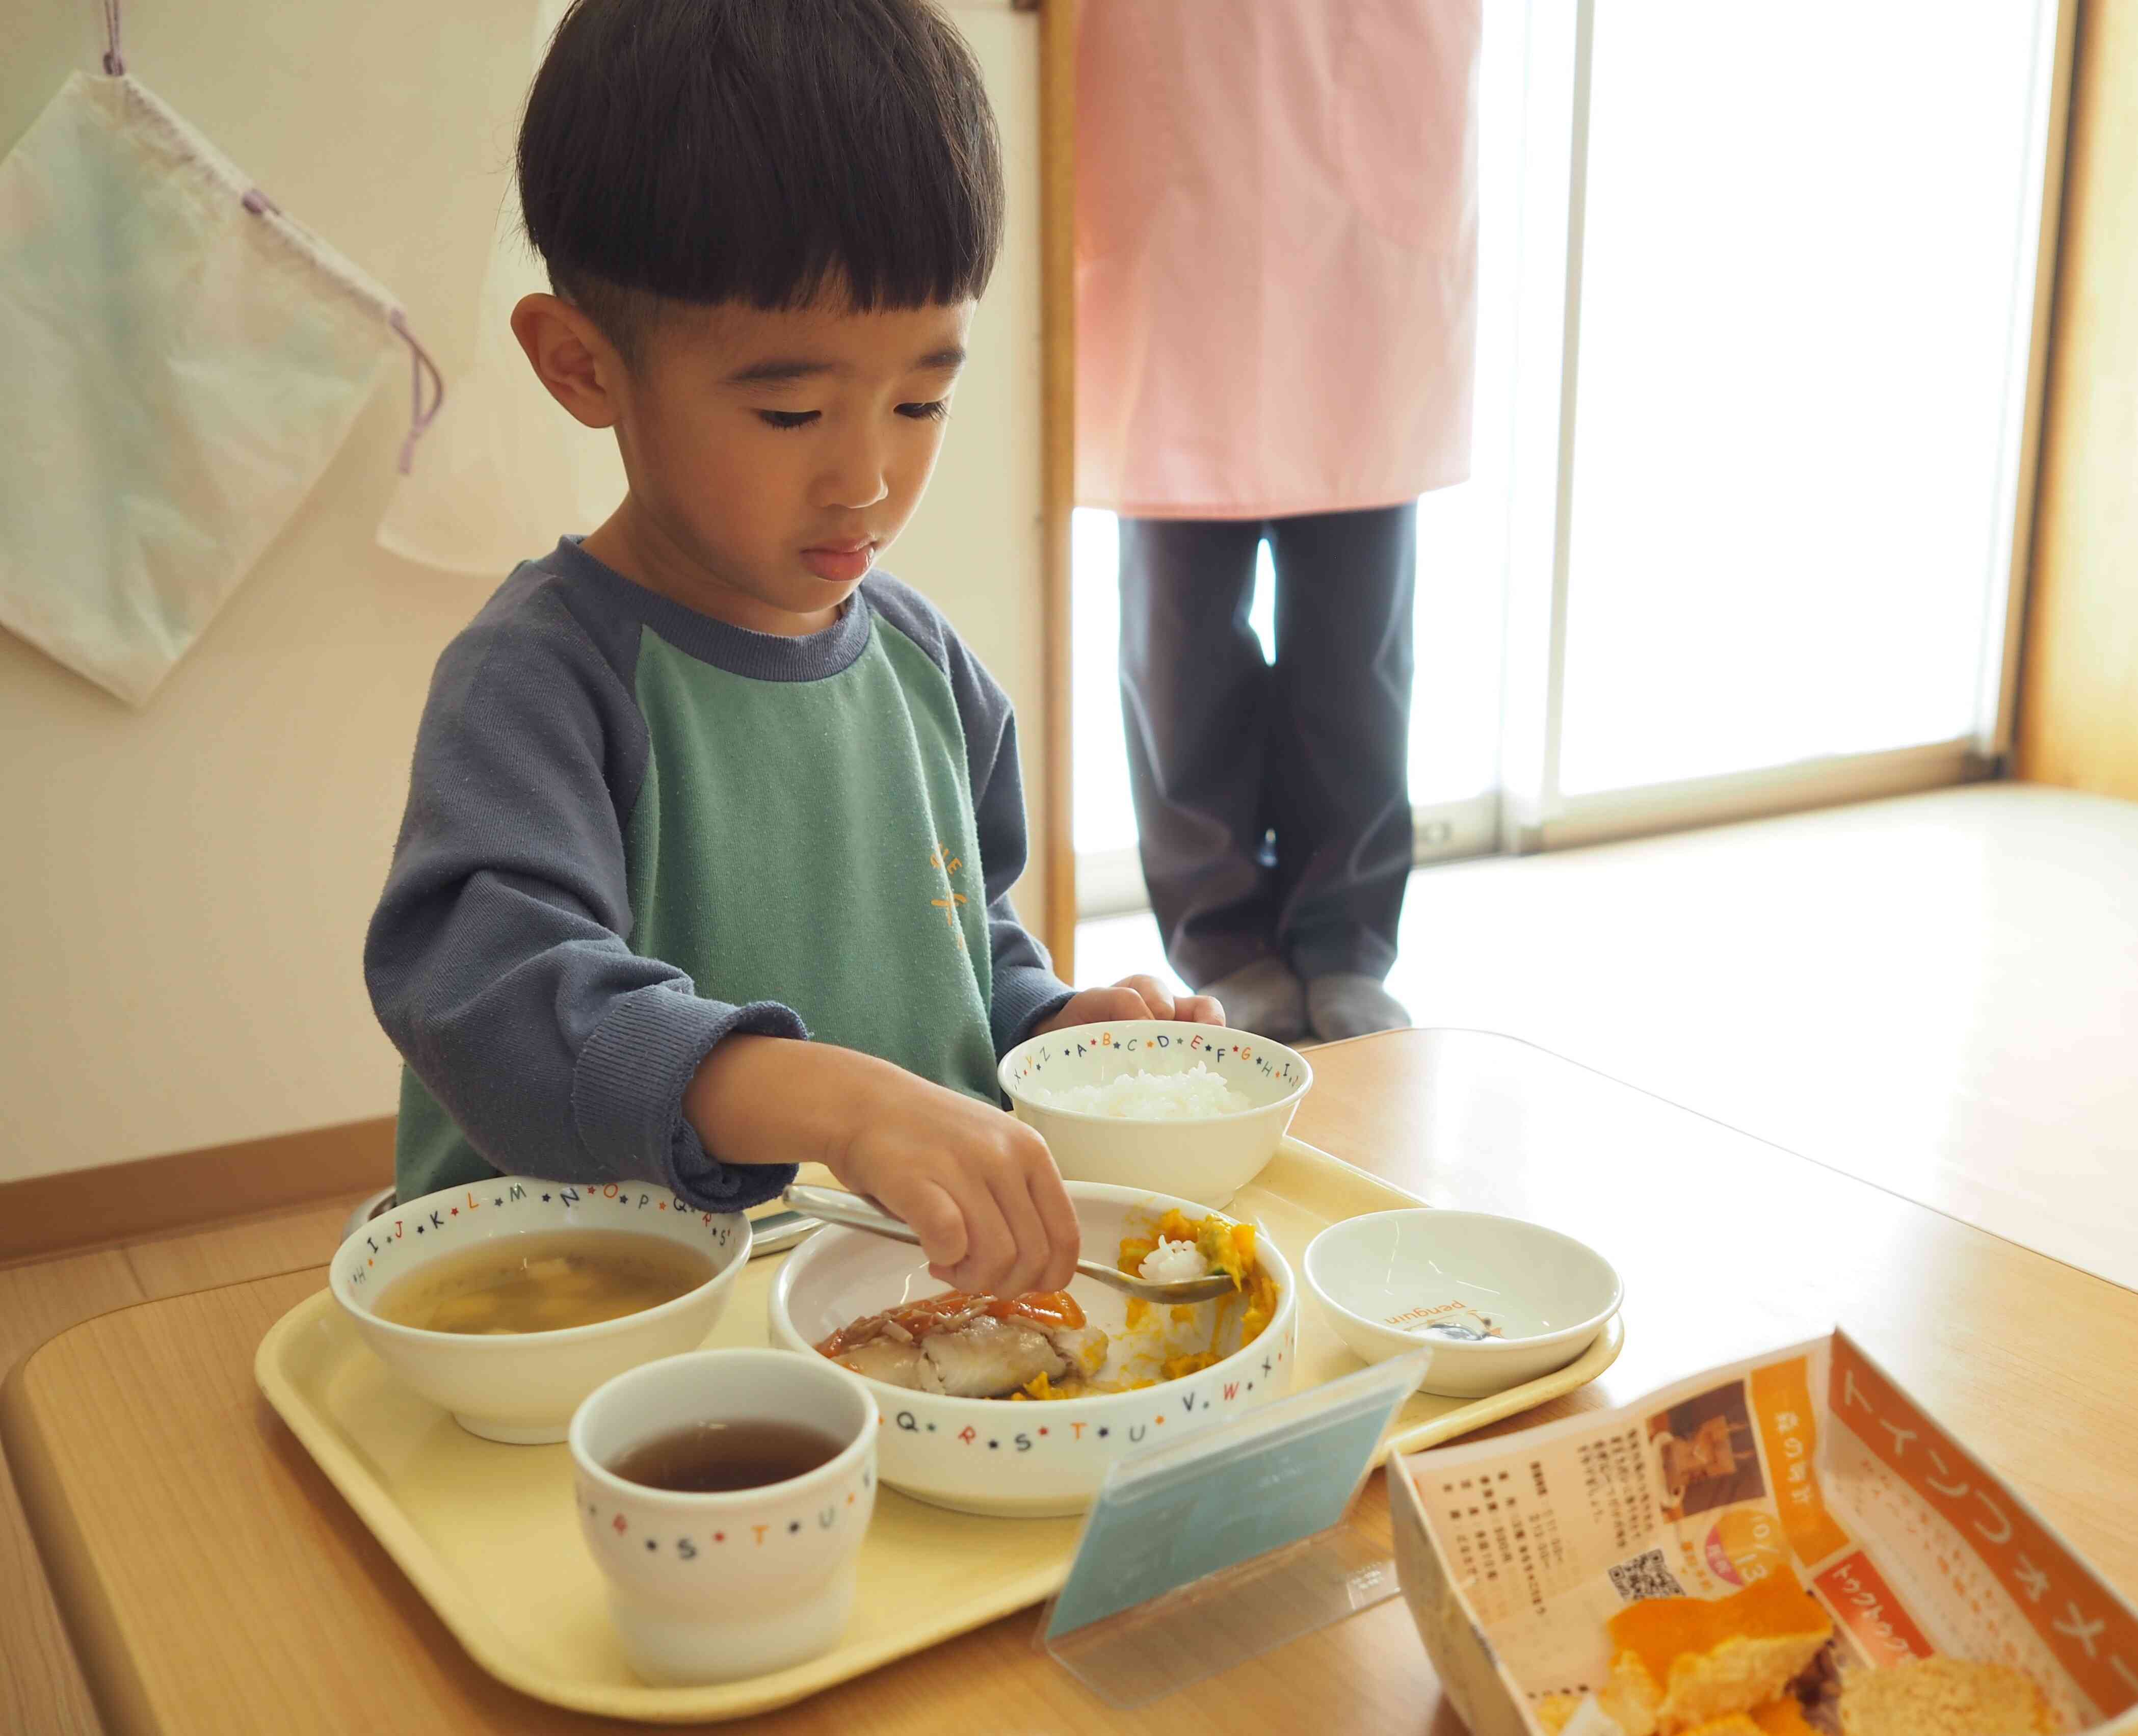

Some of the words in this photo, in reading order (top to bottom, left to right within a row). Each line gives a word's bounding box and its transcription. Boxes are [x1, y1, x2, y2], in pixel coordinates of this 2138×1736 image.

[1025, 1056, 1033, 1068] Y
[1039, 1046, 1051, 1062] Z
[1077, 1043, 1087, 1057] A
[1102, 1032, 1111, 1045] B
[1127, 1039, 1138, 1051] C
[1156, 1035, 1169, 1048] D
[1190, 1035, 1203, 1050] E
[1217, 1048, 1226, 1063] F
[1241, 1046, 1252, 1061] G
[1261, 1061, 1273, 1077] H
[1282, 1063, 1290, 1076] I
[367, 1237, 379, 1254] I
[395, 1221, 403, 1238] J
[430, 1211, 444, 1229] K
[467, 1191, 479, 1209] L
[510, 1183, 527, 1202] M
[560, 1188, 580, 1207] N
[603, 1183, 619, 1199] O
[638, 1194, 649, 1209] P
[673, 1198, 687, 1213] Q
[1384, 1299, 1466, 1324] penguin
[896, 1411, 919, 1433] Q
[958, 1426, 976, 1444] R
[1015, 1434, 1032, 1452] S
[1071, 1423, 1087, 1439] T
[1129, 1425, 1146, 1442] U
[1182, 1392, 1195, 1412] V
[1224, 1381, 1240, 1401] W
[677, 1537, 697, 1560] S
[752, 1524, 770, 1546] T
[819, 1507, 836, 1529] U
